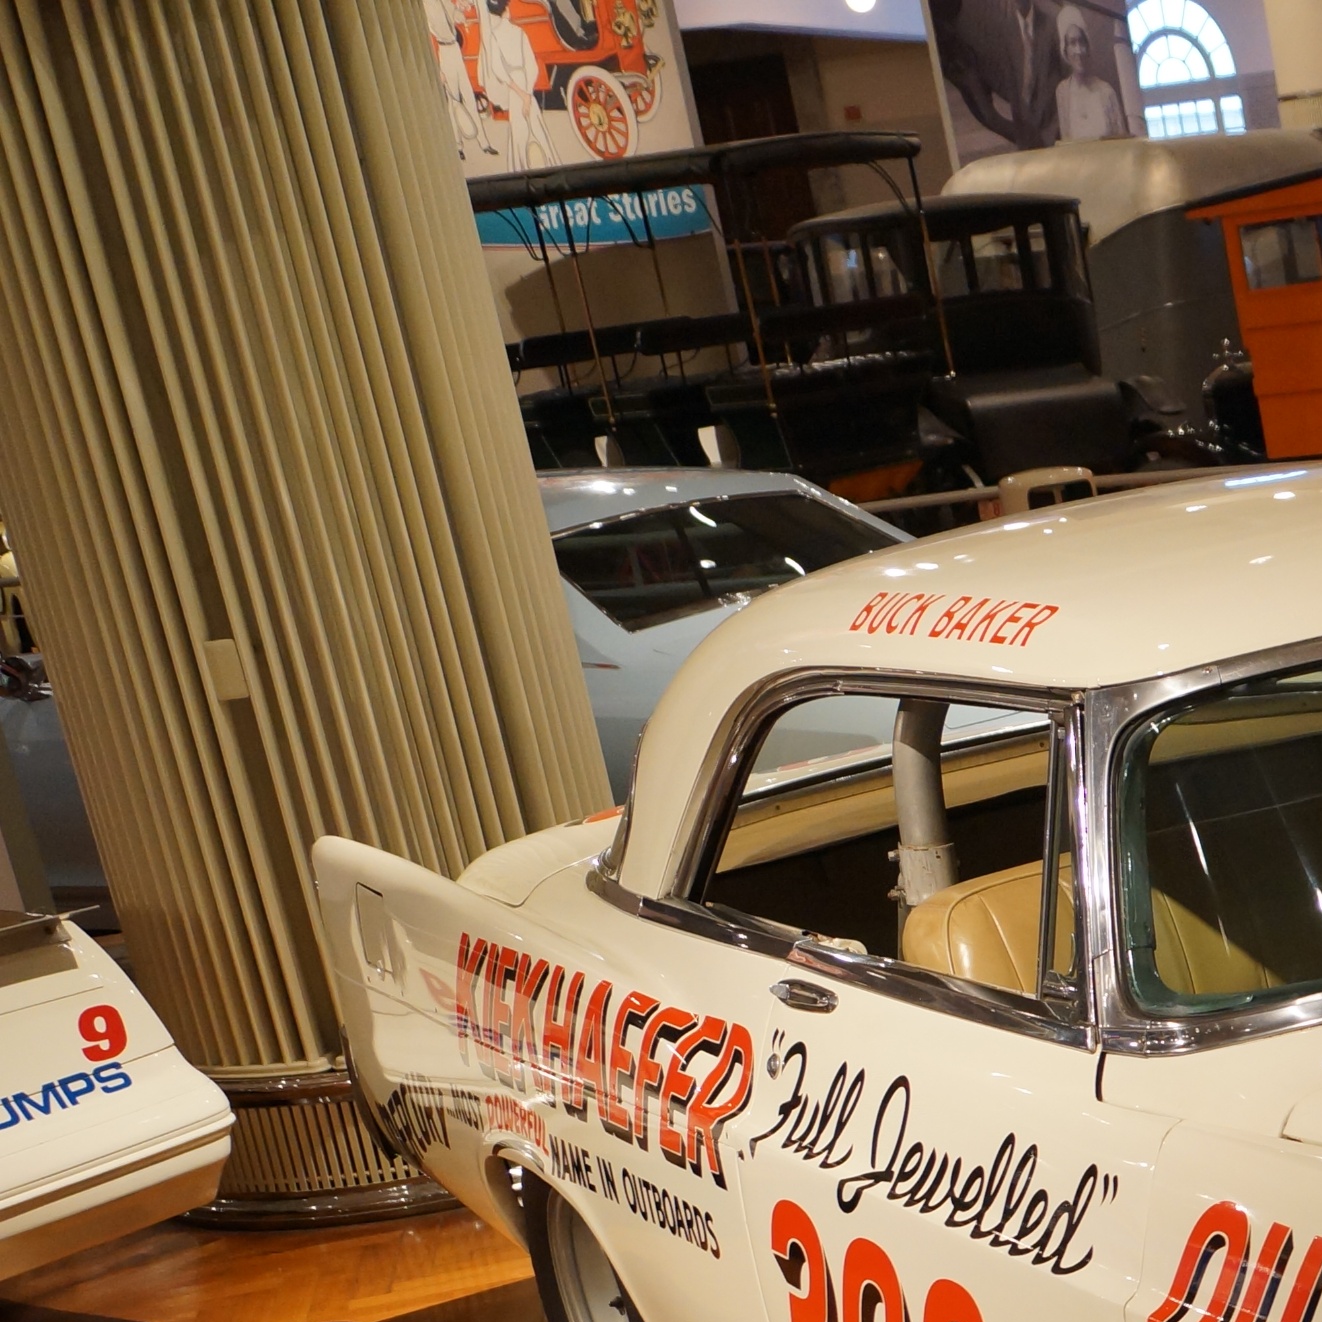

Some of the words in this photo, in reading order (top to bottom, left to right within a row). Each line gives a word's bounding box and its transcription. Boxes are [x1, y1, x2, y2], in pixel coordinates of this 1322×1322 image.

[607, 187, 697, 223] Stories
[849, 592, 946, 636] BUCK
[927, 595, 1060, 647] BAKER
[78, 1004, 128, 1062] 9
[456, 932, 755, 1190] KIEKHAEFER
[485, 1093, 550, 1157] POWERFUL
[549, 1133, 597, 1193] NAME
[596, 1156, 620, 1204] IN
[622, 1166, 721, 1259] OUTBOARDS
